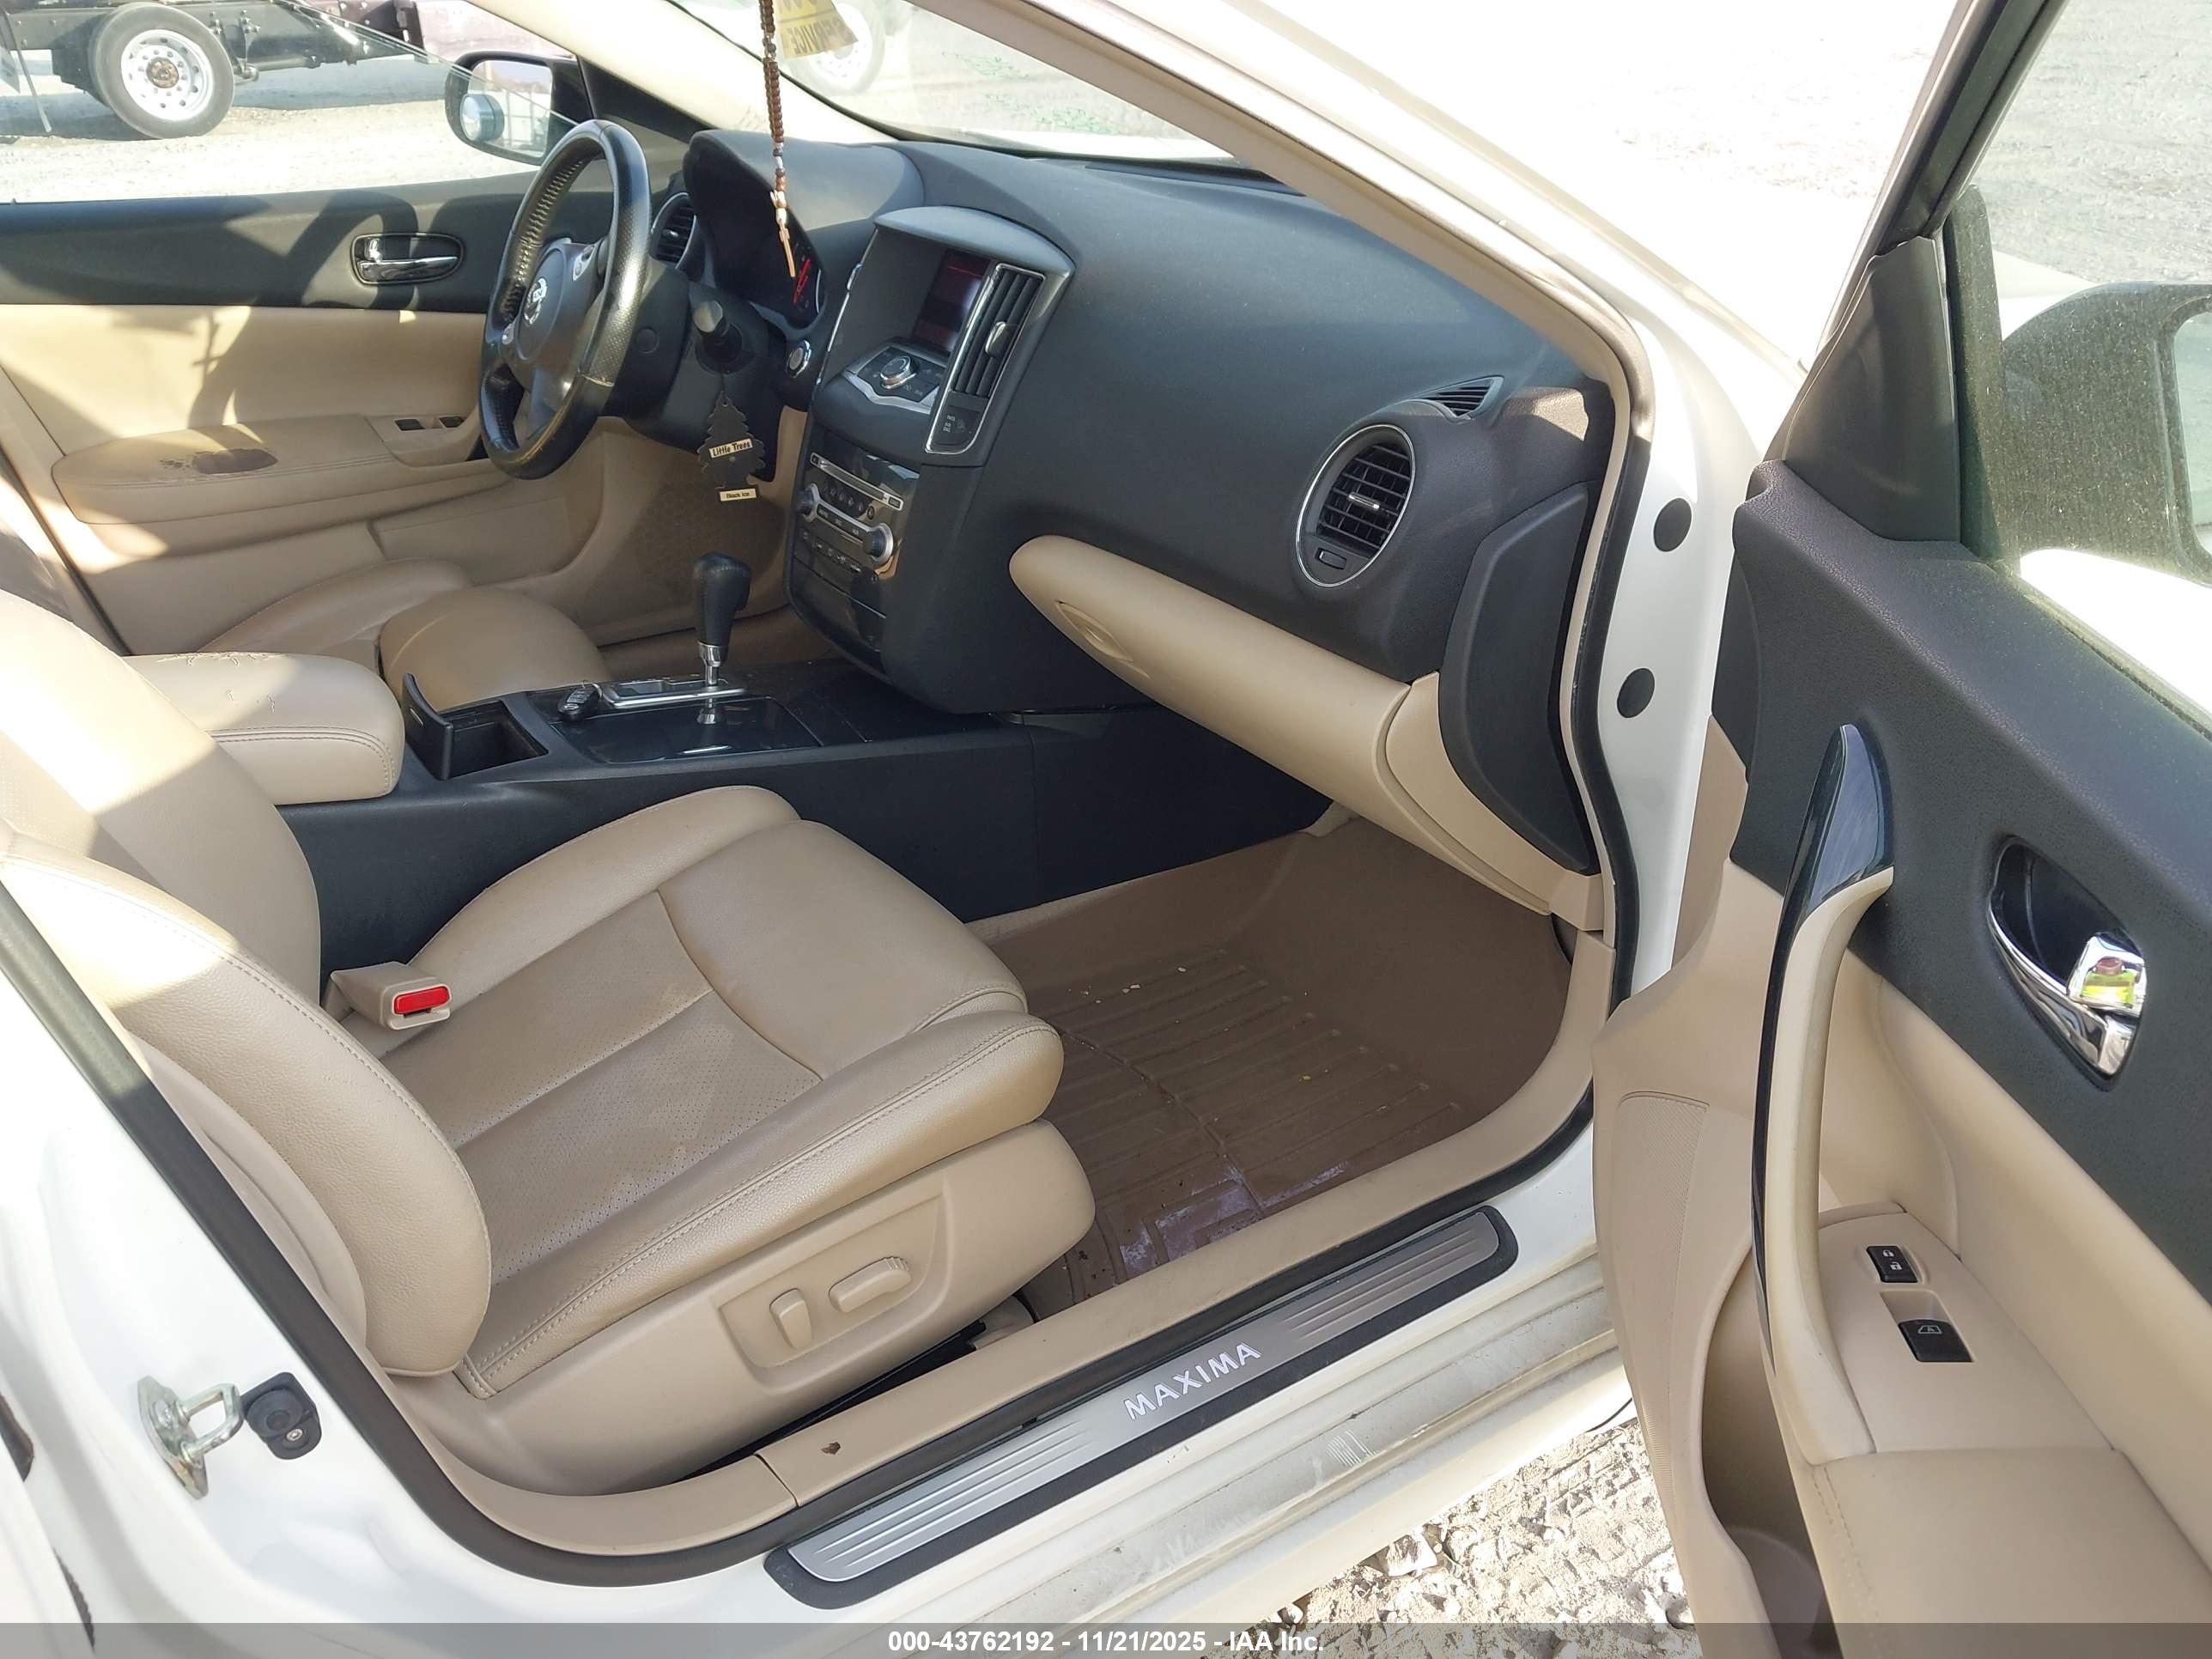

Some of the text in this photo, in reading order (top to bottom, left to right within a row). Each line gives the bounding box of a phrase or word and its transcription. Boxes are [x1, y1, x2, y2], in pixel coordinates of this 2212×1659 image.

[713, 441, 750, 456] Little Trees
[1124, 1342, 1261, 1420] MAXIMA
